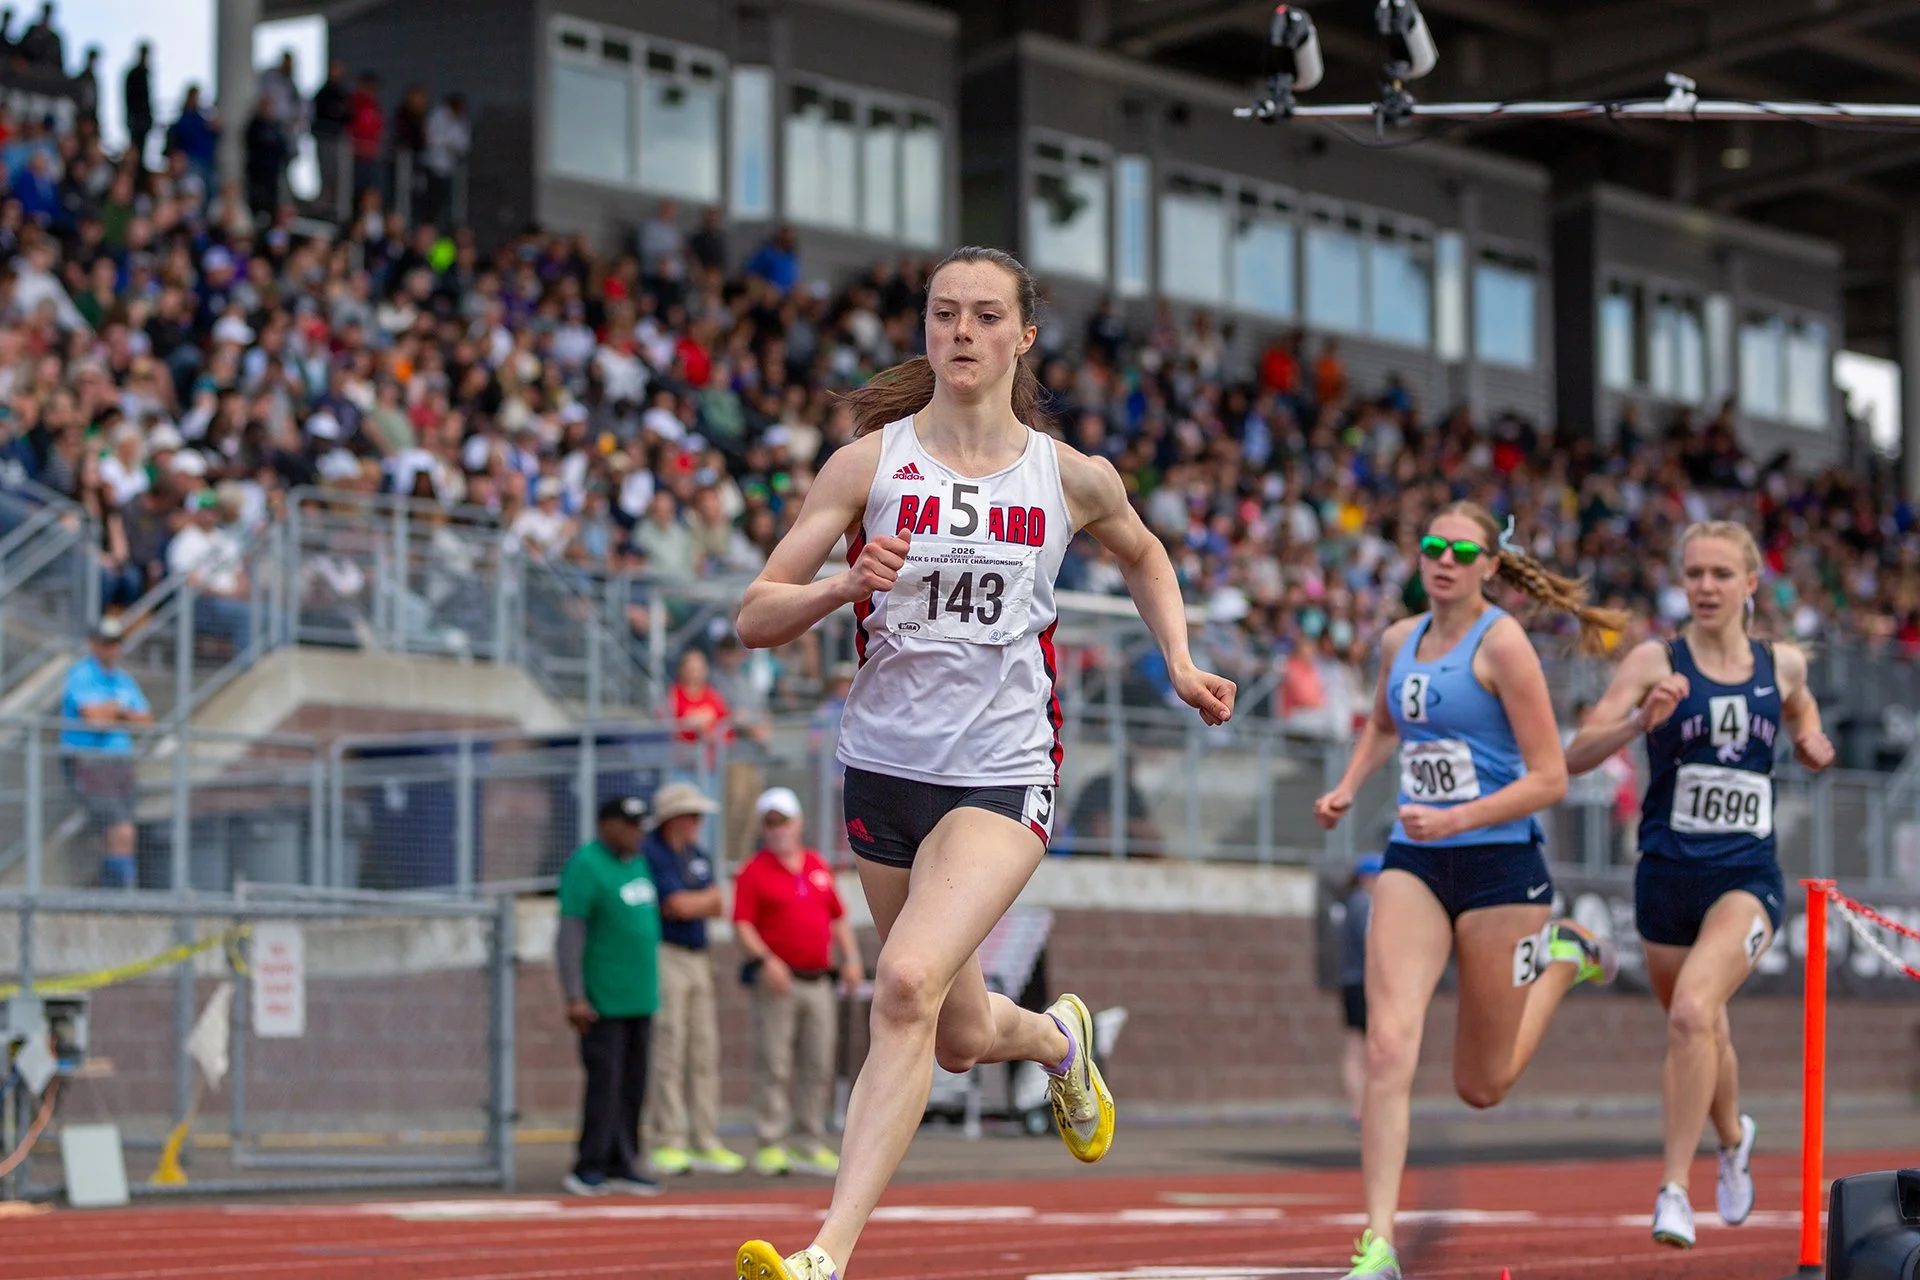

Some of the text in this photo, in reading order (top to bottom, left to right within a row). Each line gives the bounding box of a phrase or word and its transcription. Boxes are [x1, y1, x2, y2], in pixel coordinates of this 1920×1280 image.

[892, 472, 925, 481] adidas
[896, 495, 1046, 548] BAARD
[950, 483, 979, 537] 5
[951, 547, 975, 555] 2026
[970, 559, 1024, 567] CHAMPIONSHIPS
[922, 570, 1005, 625] 143
[1408, 679, 1422, 719] 3
[1719, 702, 1741, 742] 4
[1688, 784, 1760, 827] 1699
[1519, 940, 1534, 981] 3
